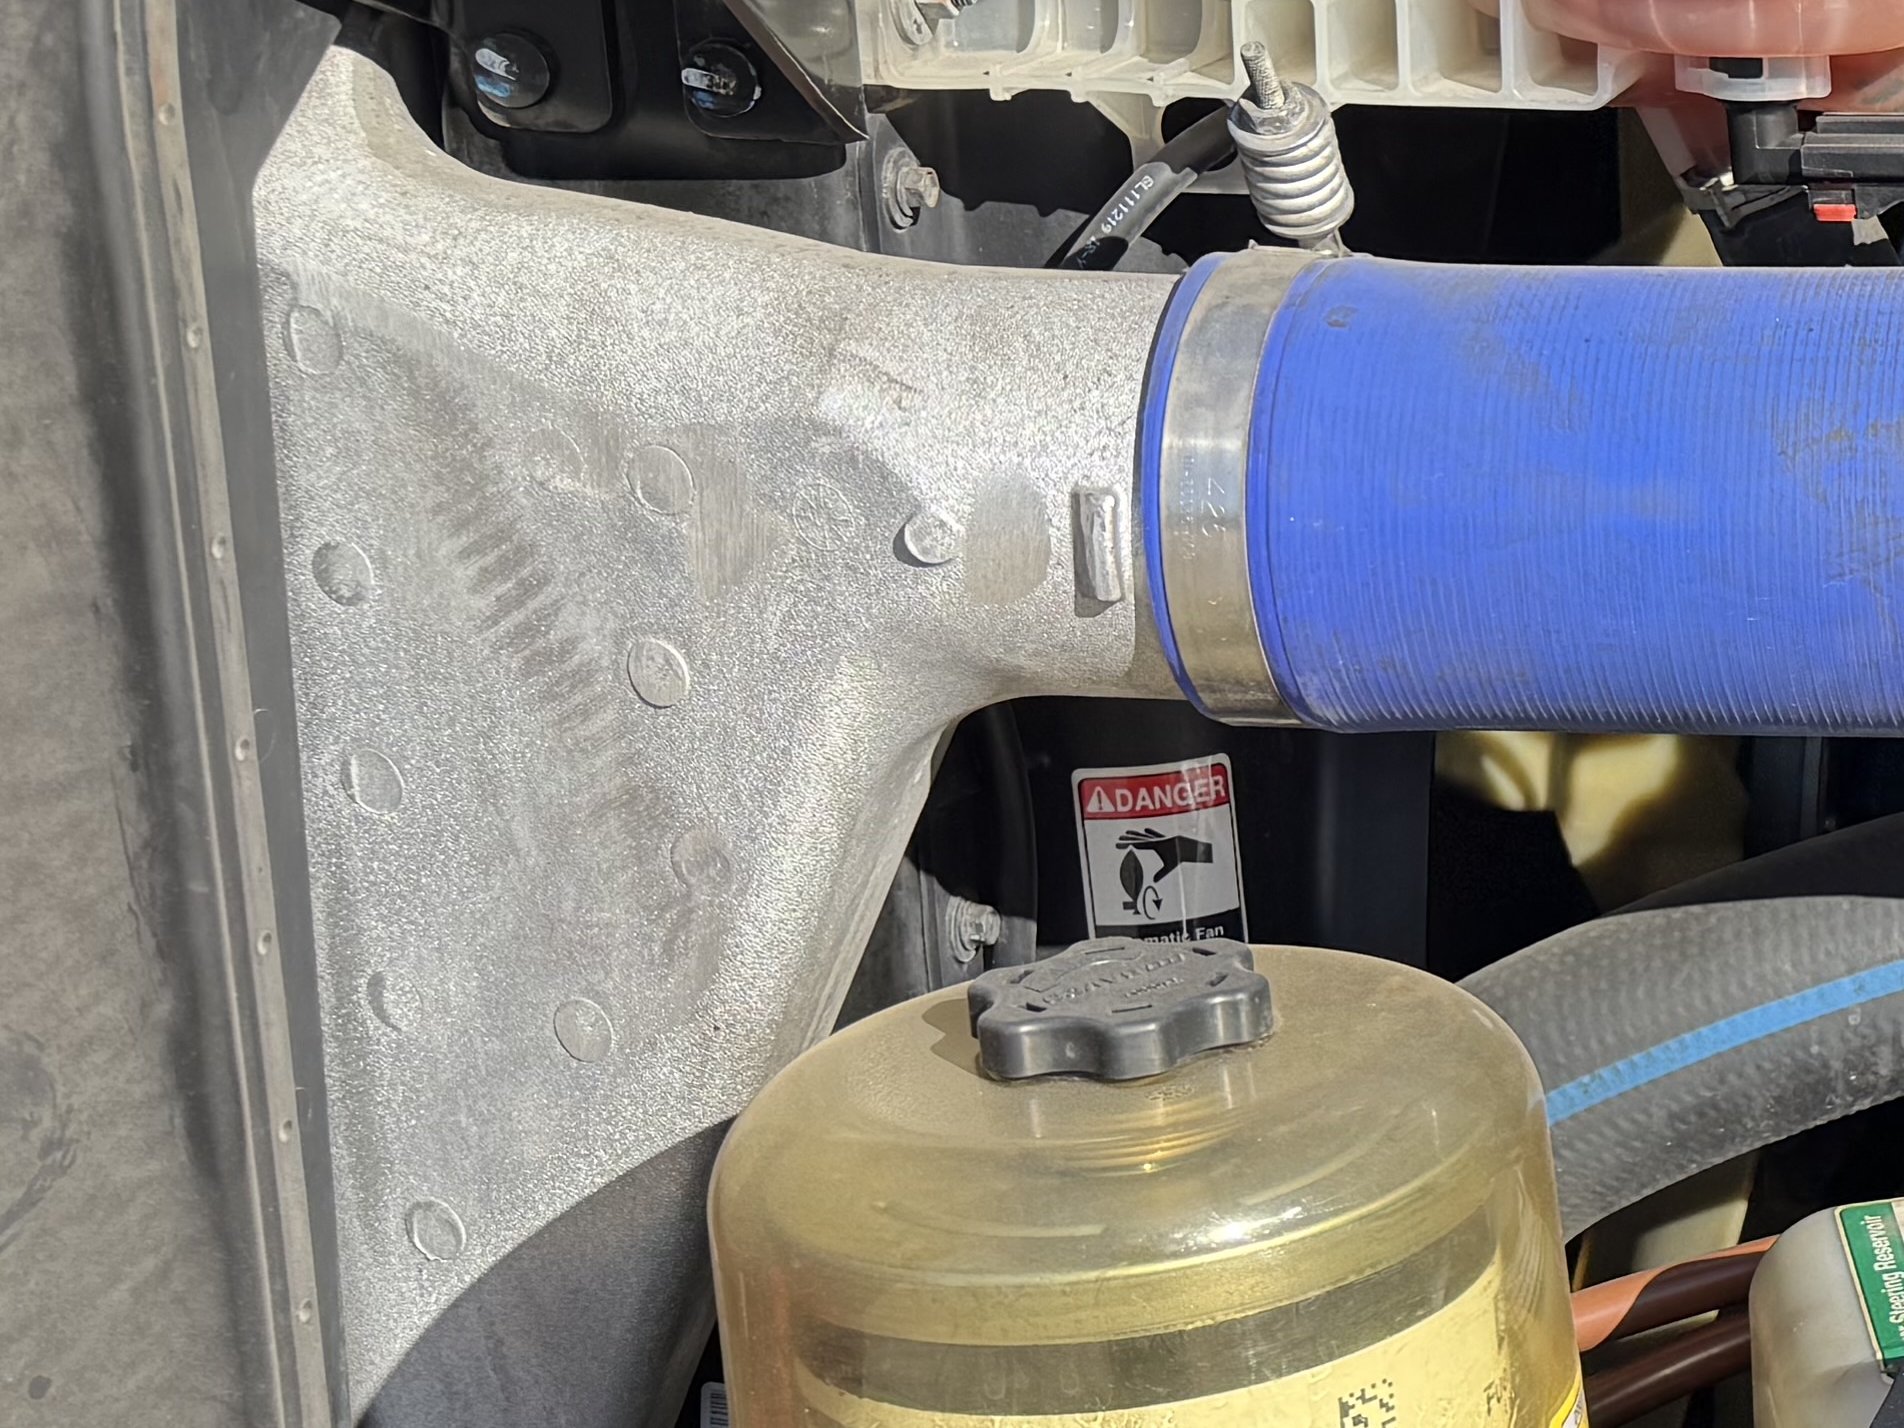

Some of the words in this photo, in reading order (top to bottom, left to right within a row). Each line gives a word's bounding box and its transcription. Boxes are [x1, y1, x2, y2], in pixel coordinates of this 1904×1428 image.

[1115, 775, 1226, 812] DANGER
[1196, 925, 1224, 939] Fan
[1859, 1210, 1897, 1272] Reservoir
